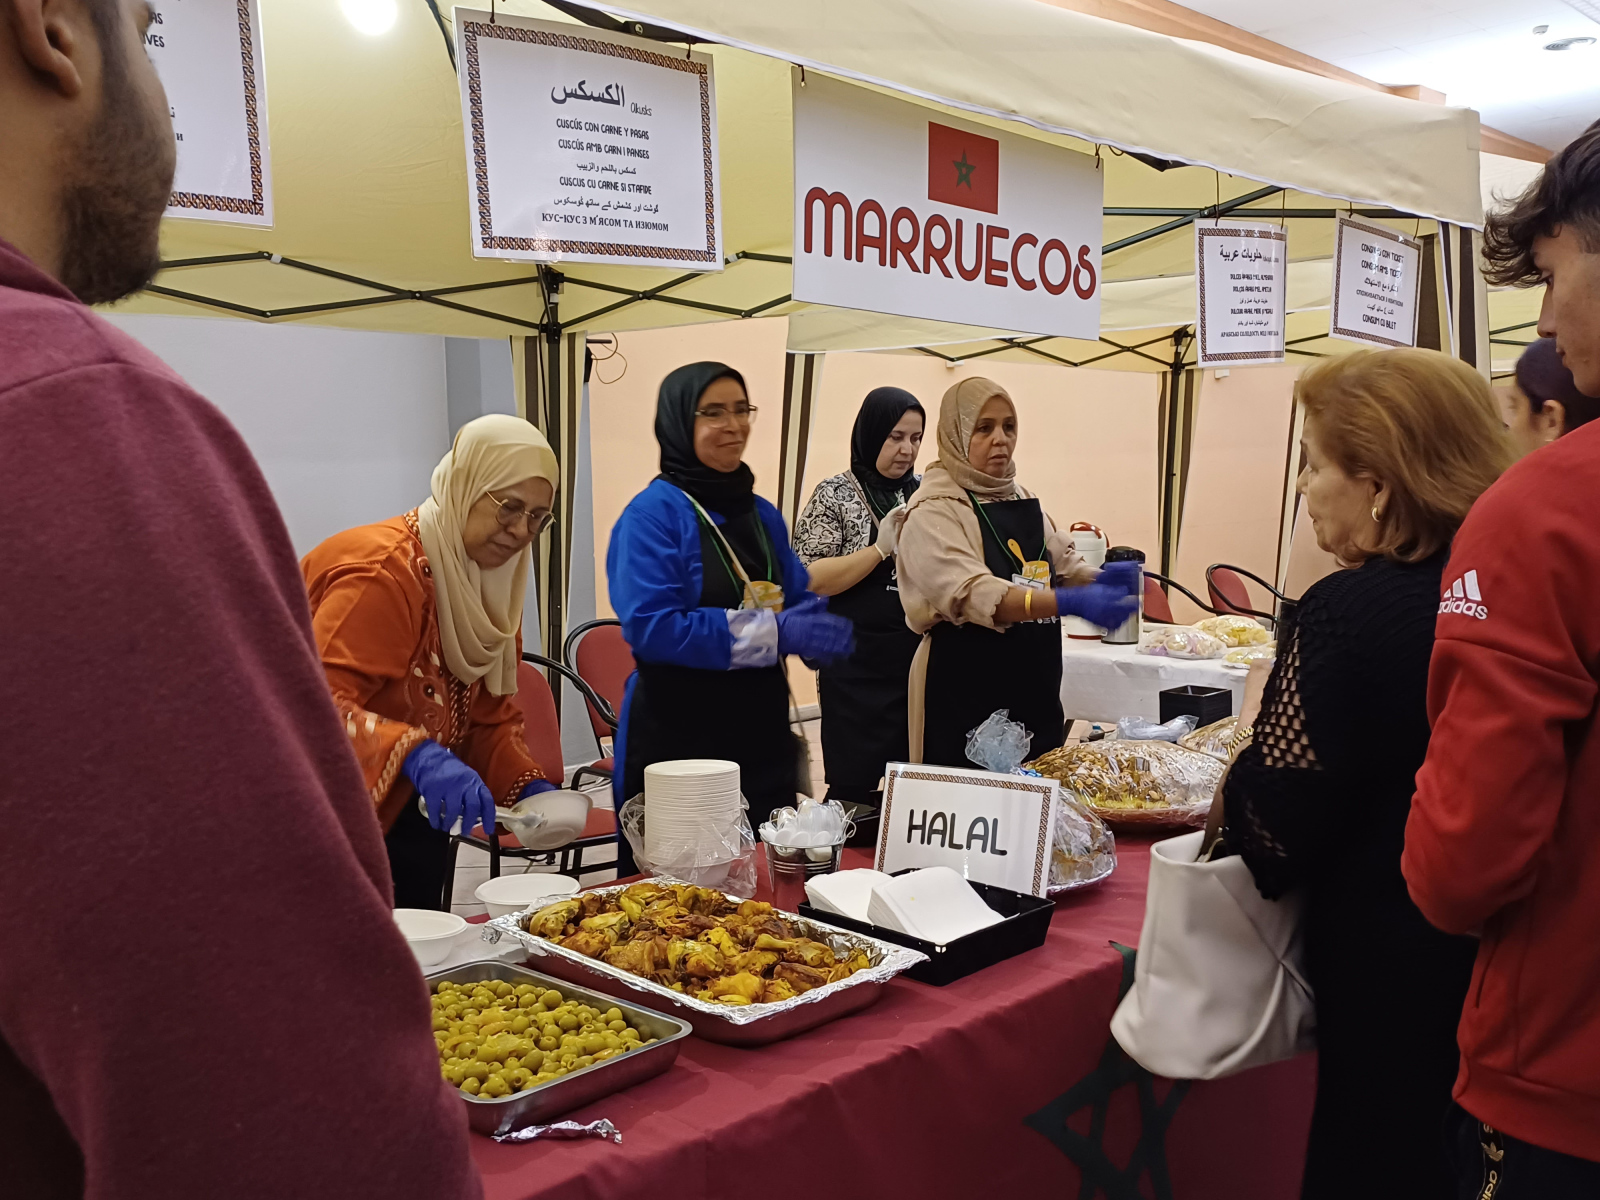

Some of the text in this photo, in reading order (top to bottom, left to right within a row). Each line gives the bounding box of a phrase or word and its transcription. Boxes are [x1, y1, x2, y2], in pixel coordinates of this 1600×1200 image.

[551, 79, 625, 108] الكسكس
[556, 117, 650, 140] CUSCÚS CON CARNE Y PASAS
[558, 138, 585, 151] CUSCÚS
[586, 142, 602, 153] AMB
[604, 144, 622, 156] CARN
[626, 148, 650, 160] PANSES
[576, 162, 637, 176] كسكس باللحم والزبيب
[559, 176, 652, 195] CUSCUS CU CARNE SI STAFIDE
[541, 212, 581, 224] КУС-КУС
[582, 215, 588, 225] З
[622, 219, 634, 229] ТА
[635, 220, 669, 232] ИЗЮМОМ
[804, 187, 1096, 299] MARRUECOS
[1219, 244, 1239, 262] عربية
[1241, 248, 1262, 262] حلويات
[1382, 249, 1391, 260] CON
[1362, 313, 1380, 326] CONSUM
[1386, 319, 1397, 330] BILET
[1437, 598, 1488, 620] adidas
[906, 808, 1008, 856] HALAL
